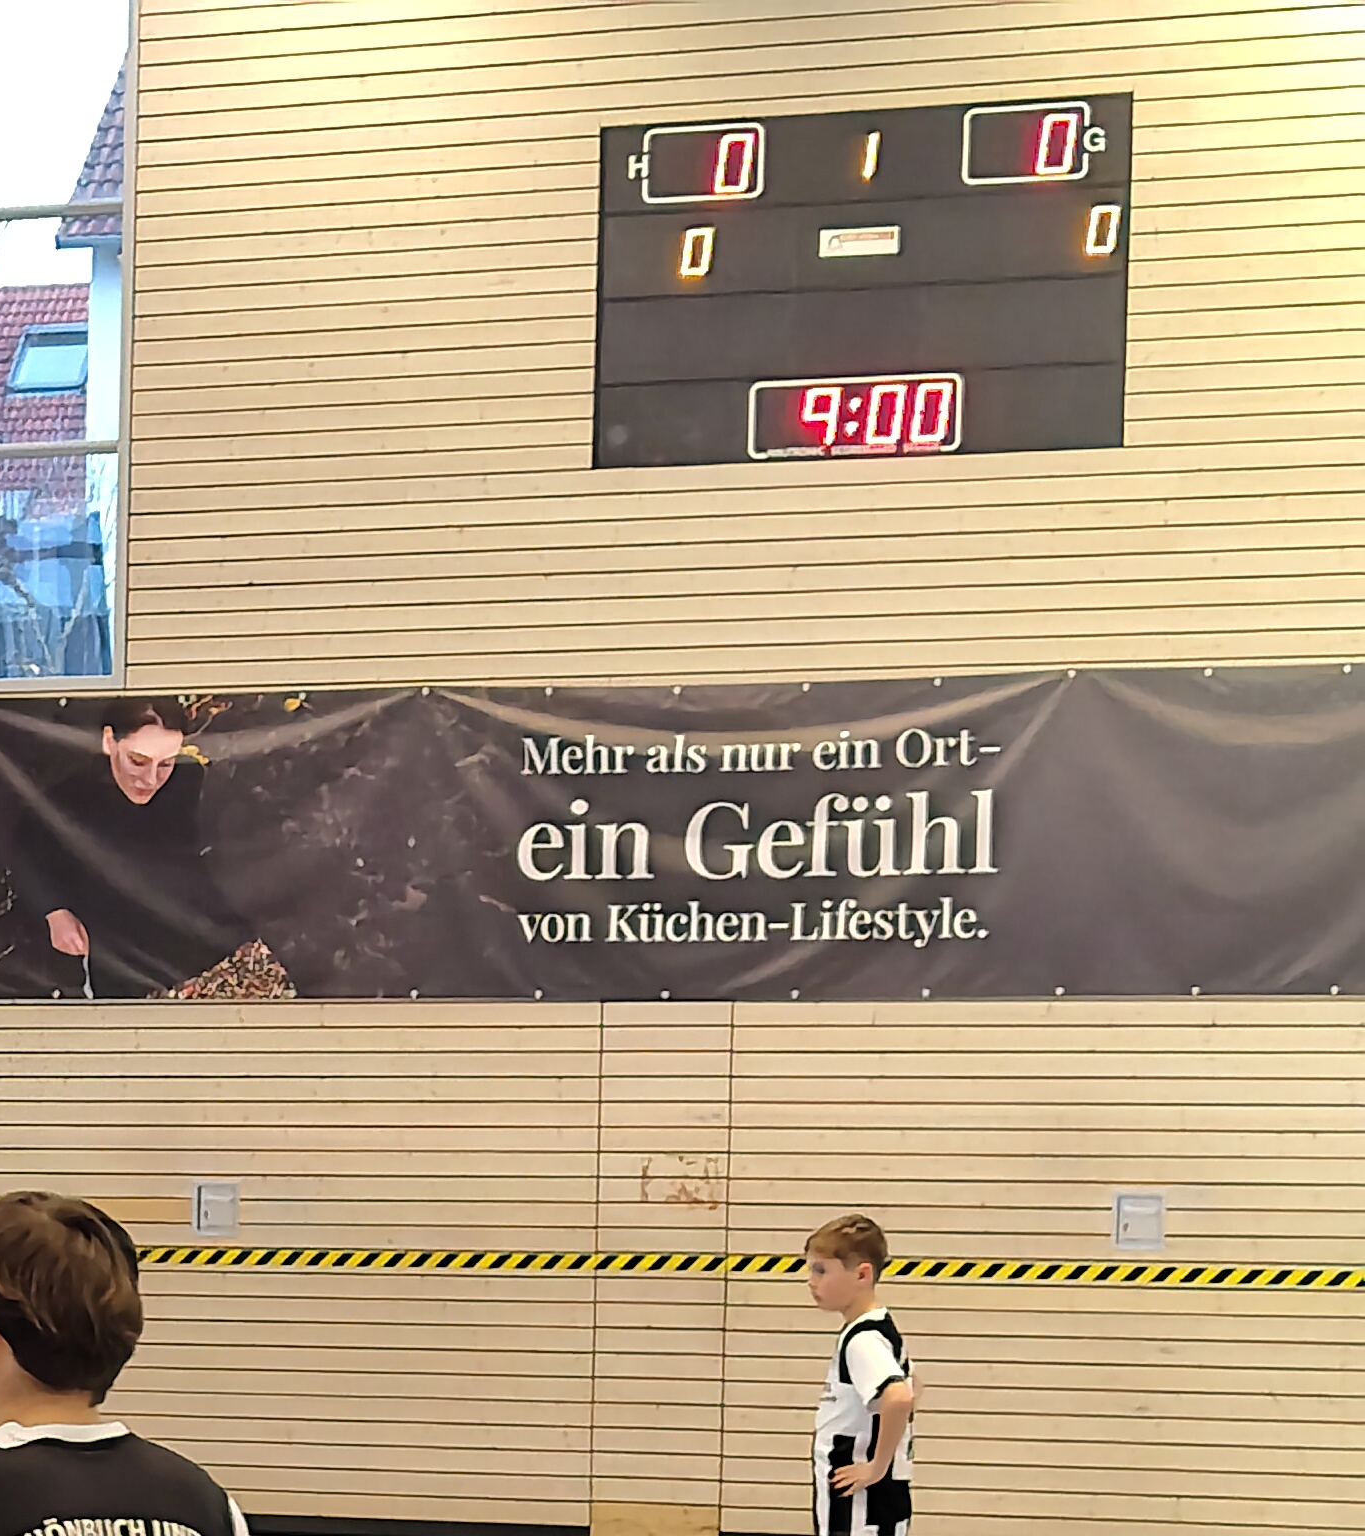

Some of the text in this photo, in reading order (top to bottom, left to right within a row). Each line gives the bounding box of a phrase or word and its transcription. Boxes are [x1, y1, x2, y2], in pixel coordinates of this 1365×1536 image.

[714, 132, 755, 195] 0
[861, 131, 880, 181] 1
[1037, 112, 1078, 176] 0
[1084, 126, 1107, 153] G
[628, 154, 650, 181] H
[679, 226, 716, 277] 0
[1086, 204, 1121, 255] 0
[801, 382, 954, 447] 9:00
[520, 728, 1002, 775] Mehr als nur ein Ort-
[516, 789, 1000, 881] ein Gefühl
[519, 897, 990, 948] von Küchen-Lifestyle.
